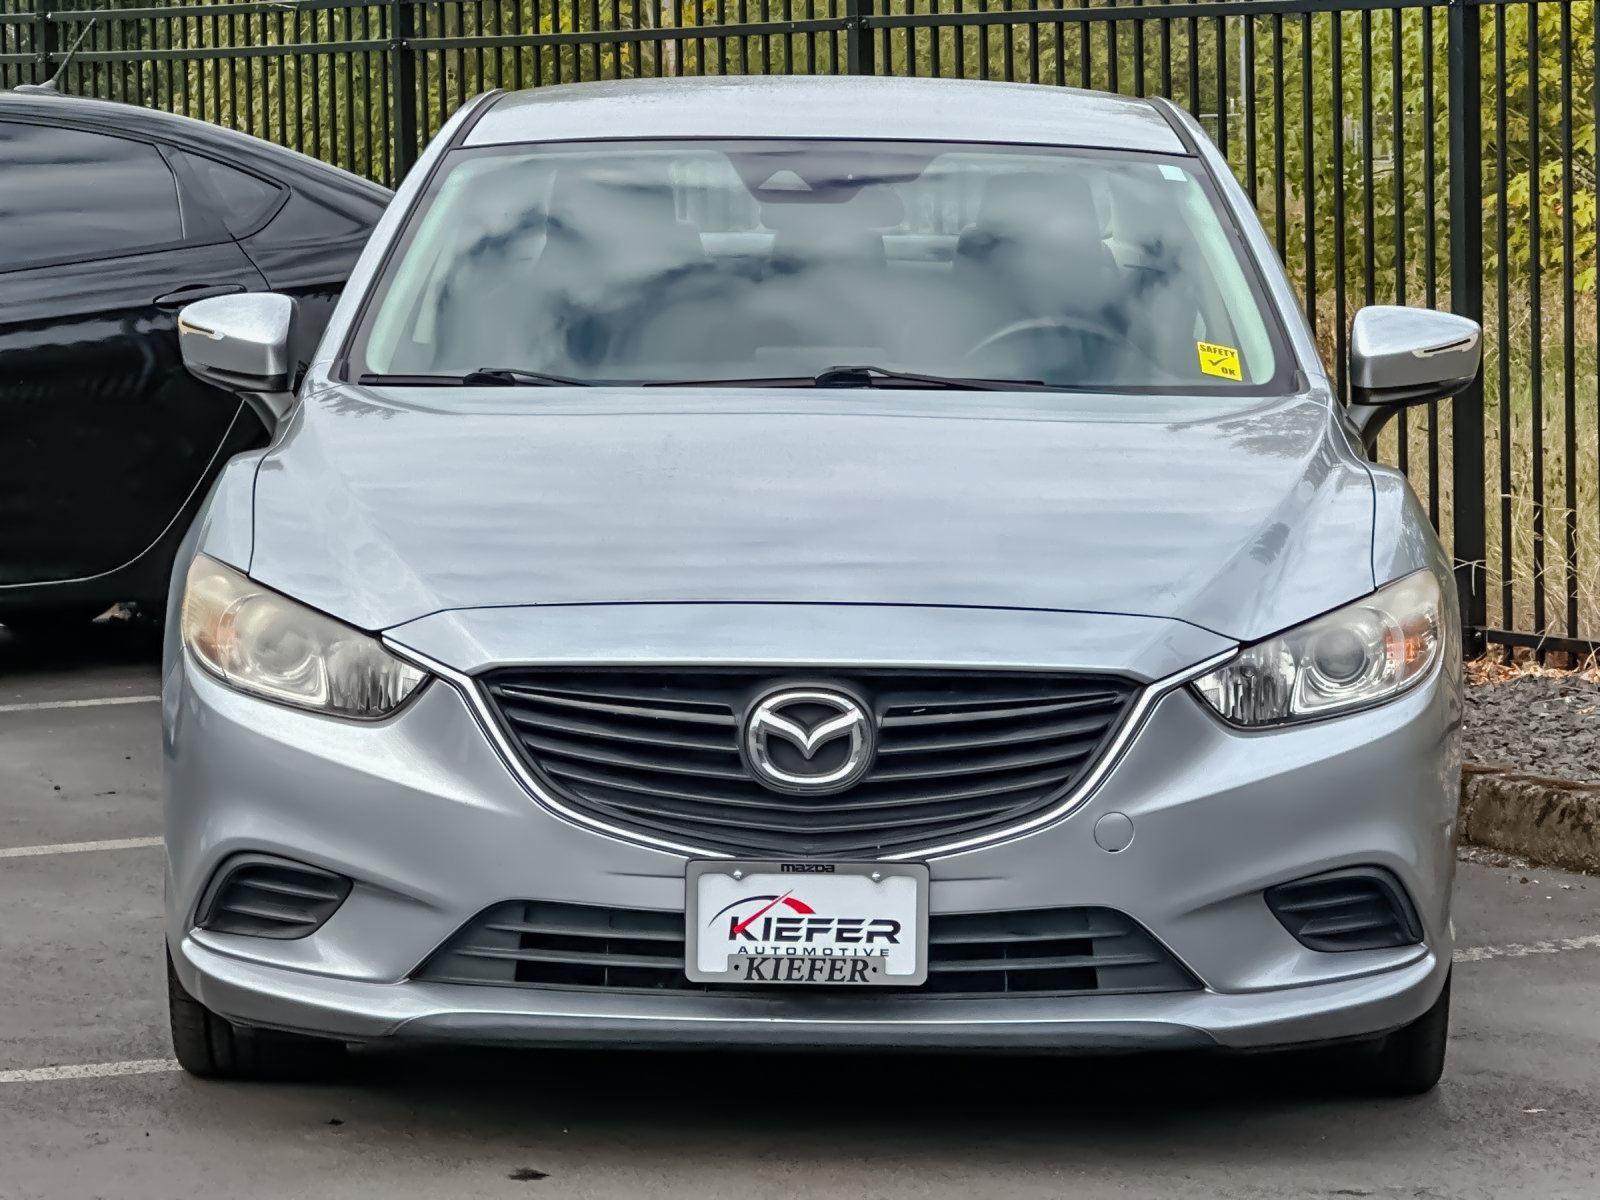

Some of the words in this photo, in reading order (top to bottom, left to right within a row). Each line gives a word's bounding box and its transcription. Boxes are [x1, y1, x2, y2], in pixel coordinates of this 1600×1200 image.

[1200, 344, 1235, 358] SAFETY
[1221, 367, 1236, 376] OK
[728, 916, 901, 944] KIEFER
[737, 945, 889, 957] AUTOMOTIVE
[743, 957, 870, 983] KIEFER
